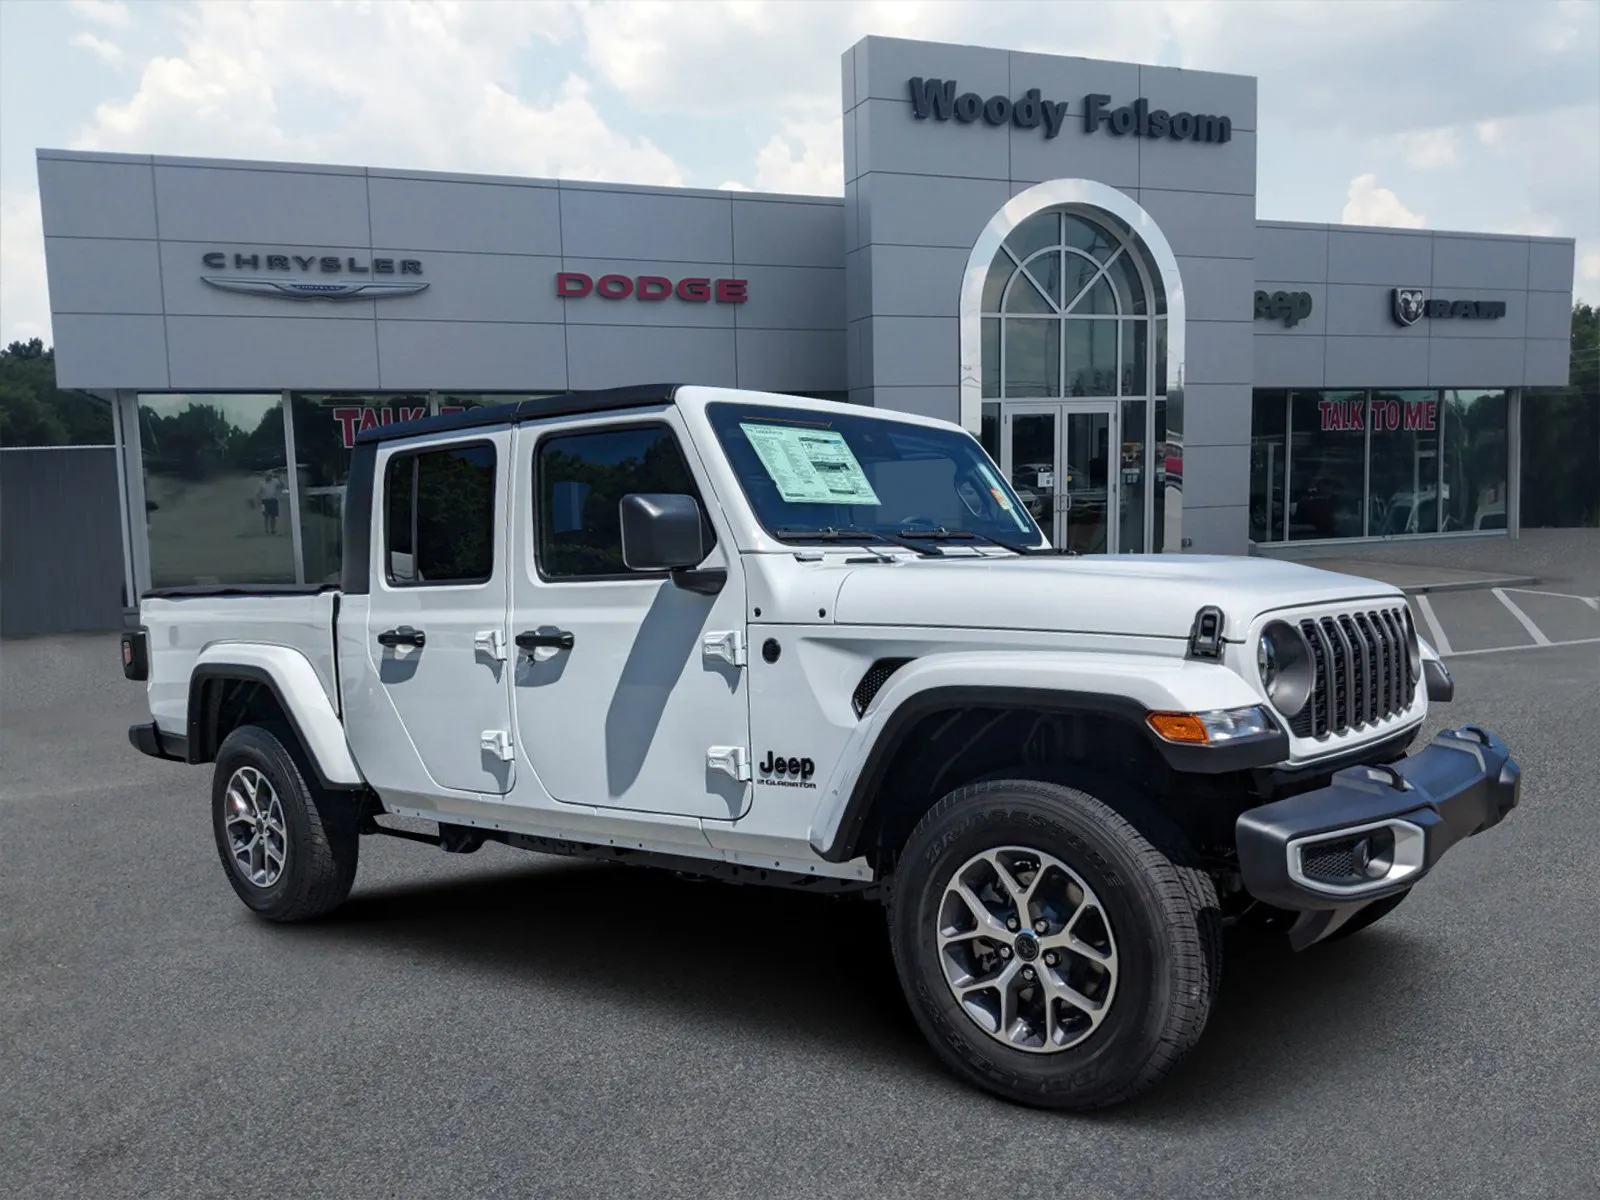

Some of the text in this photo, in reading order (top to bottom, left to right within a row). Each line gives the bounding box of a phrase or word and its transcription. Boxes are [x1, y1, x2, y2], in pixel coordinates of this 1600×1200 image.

[909, 77, 1232, 143] Woody Folsom
[202, 252, 423, 275] CHRYSLER
[556, 272, 749, 304] DODGE
[1253, 290, 1313, 328] eep
[1425, 299, 1506, 319] RAM
[1317, 400, 1436, 431] TALK TO ME
[759, 750, 815, 780] Jeep
[765, 779, 817, 790] GLADIATOR
